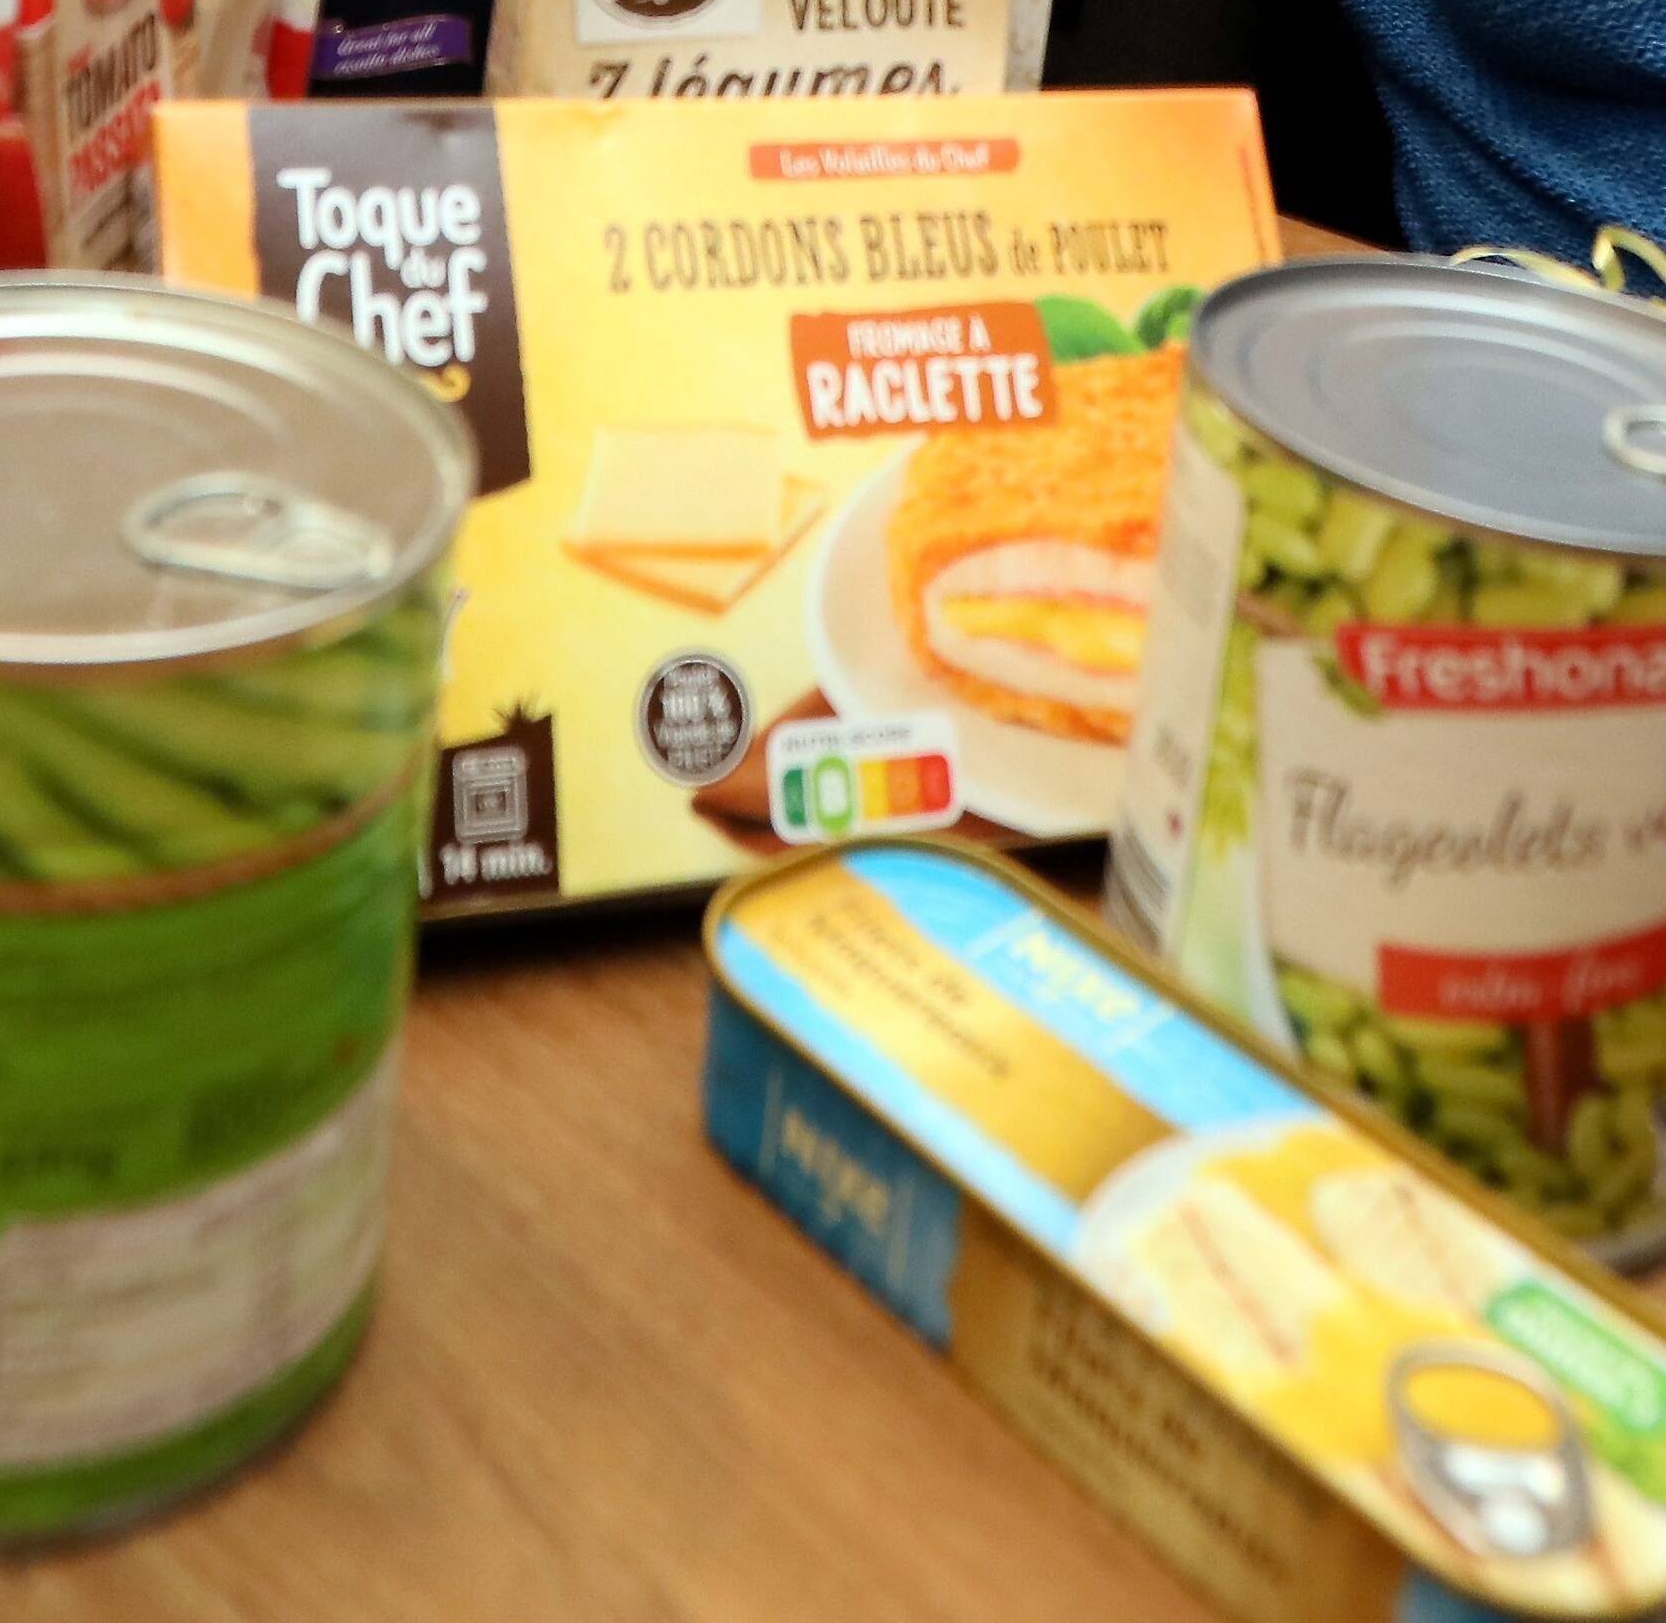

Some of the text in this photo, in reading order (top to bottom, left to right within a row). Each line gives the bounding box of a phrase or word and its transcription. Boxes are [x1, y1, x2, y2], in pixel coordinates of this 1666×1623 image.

[276, 167, 482, 270] Toque
[604, 210, 1172, 293] 2 CORDONS BLEUS de POULET
[295, 246, 489, 368] Chef
[806, 352, 1044, 428] RACLETTE
